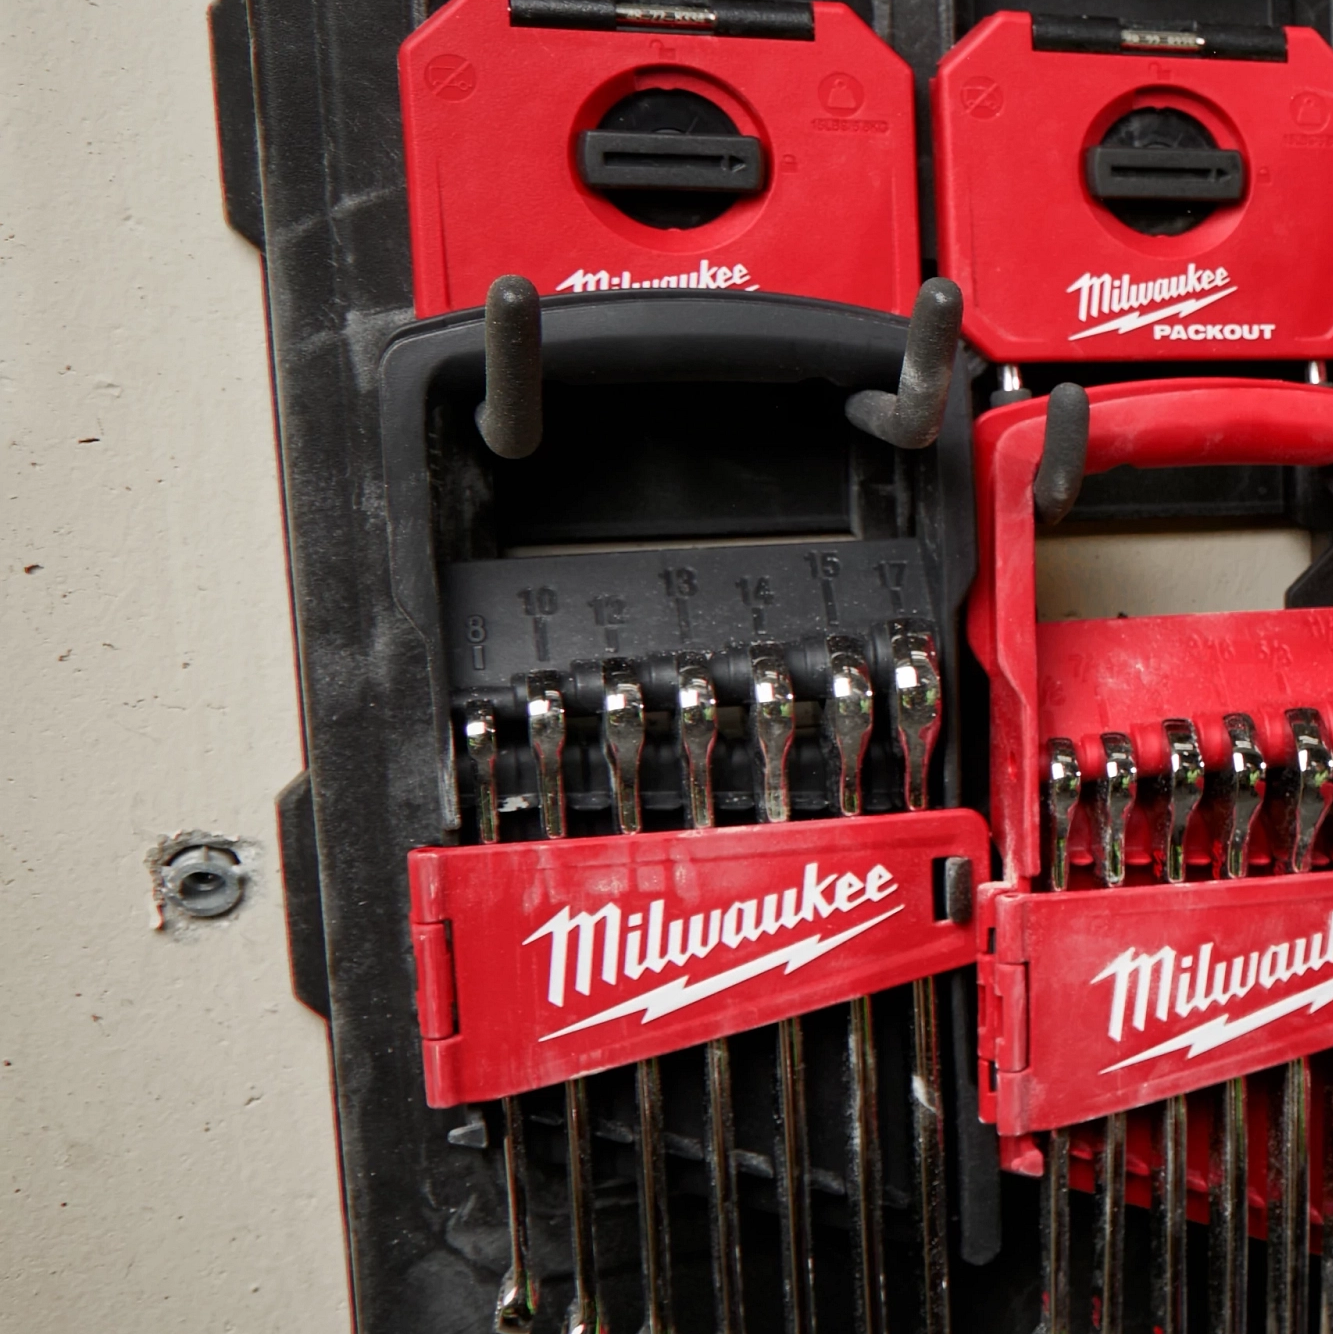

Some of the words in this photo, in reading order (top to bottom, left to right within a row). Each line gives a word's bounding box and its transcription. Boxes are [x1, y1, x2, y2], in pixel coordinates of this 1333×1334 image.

[555, 259, 751, 292] Mukee
[1067, 263, 1231, 322] Milwaukee
[1153, 323, 1276, 341] PACKOUT
[467, 615, 487, 644] 8
[517, 587, 559, 617] 10
[658, 566, 699, 598] 13
[735, 575, 775, 606] 14
[804, 550, 842, 579] 15
[873, 560, 908, 588] 17
[523, 862, 898, 1008] Milwaukee
